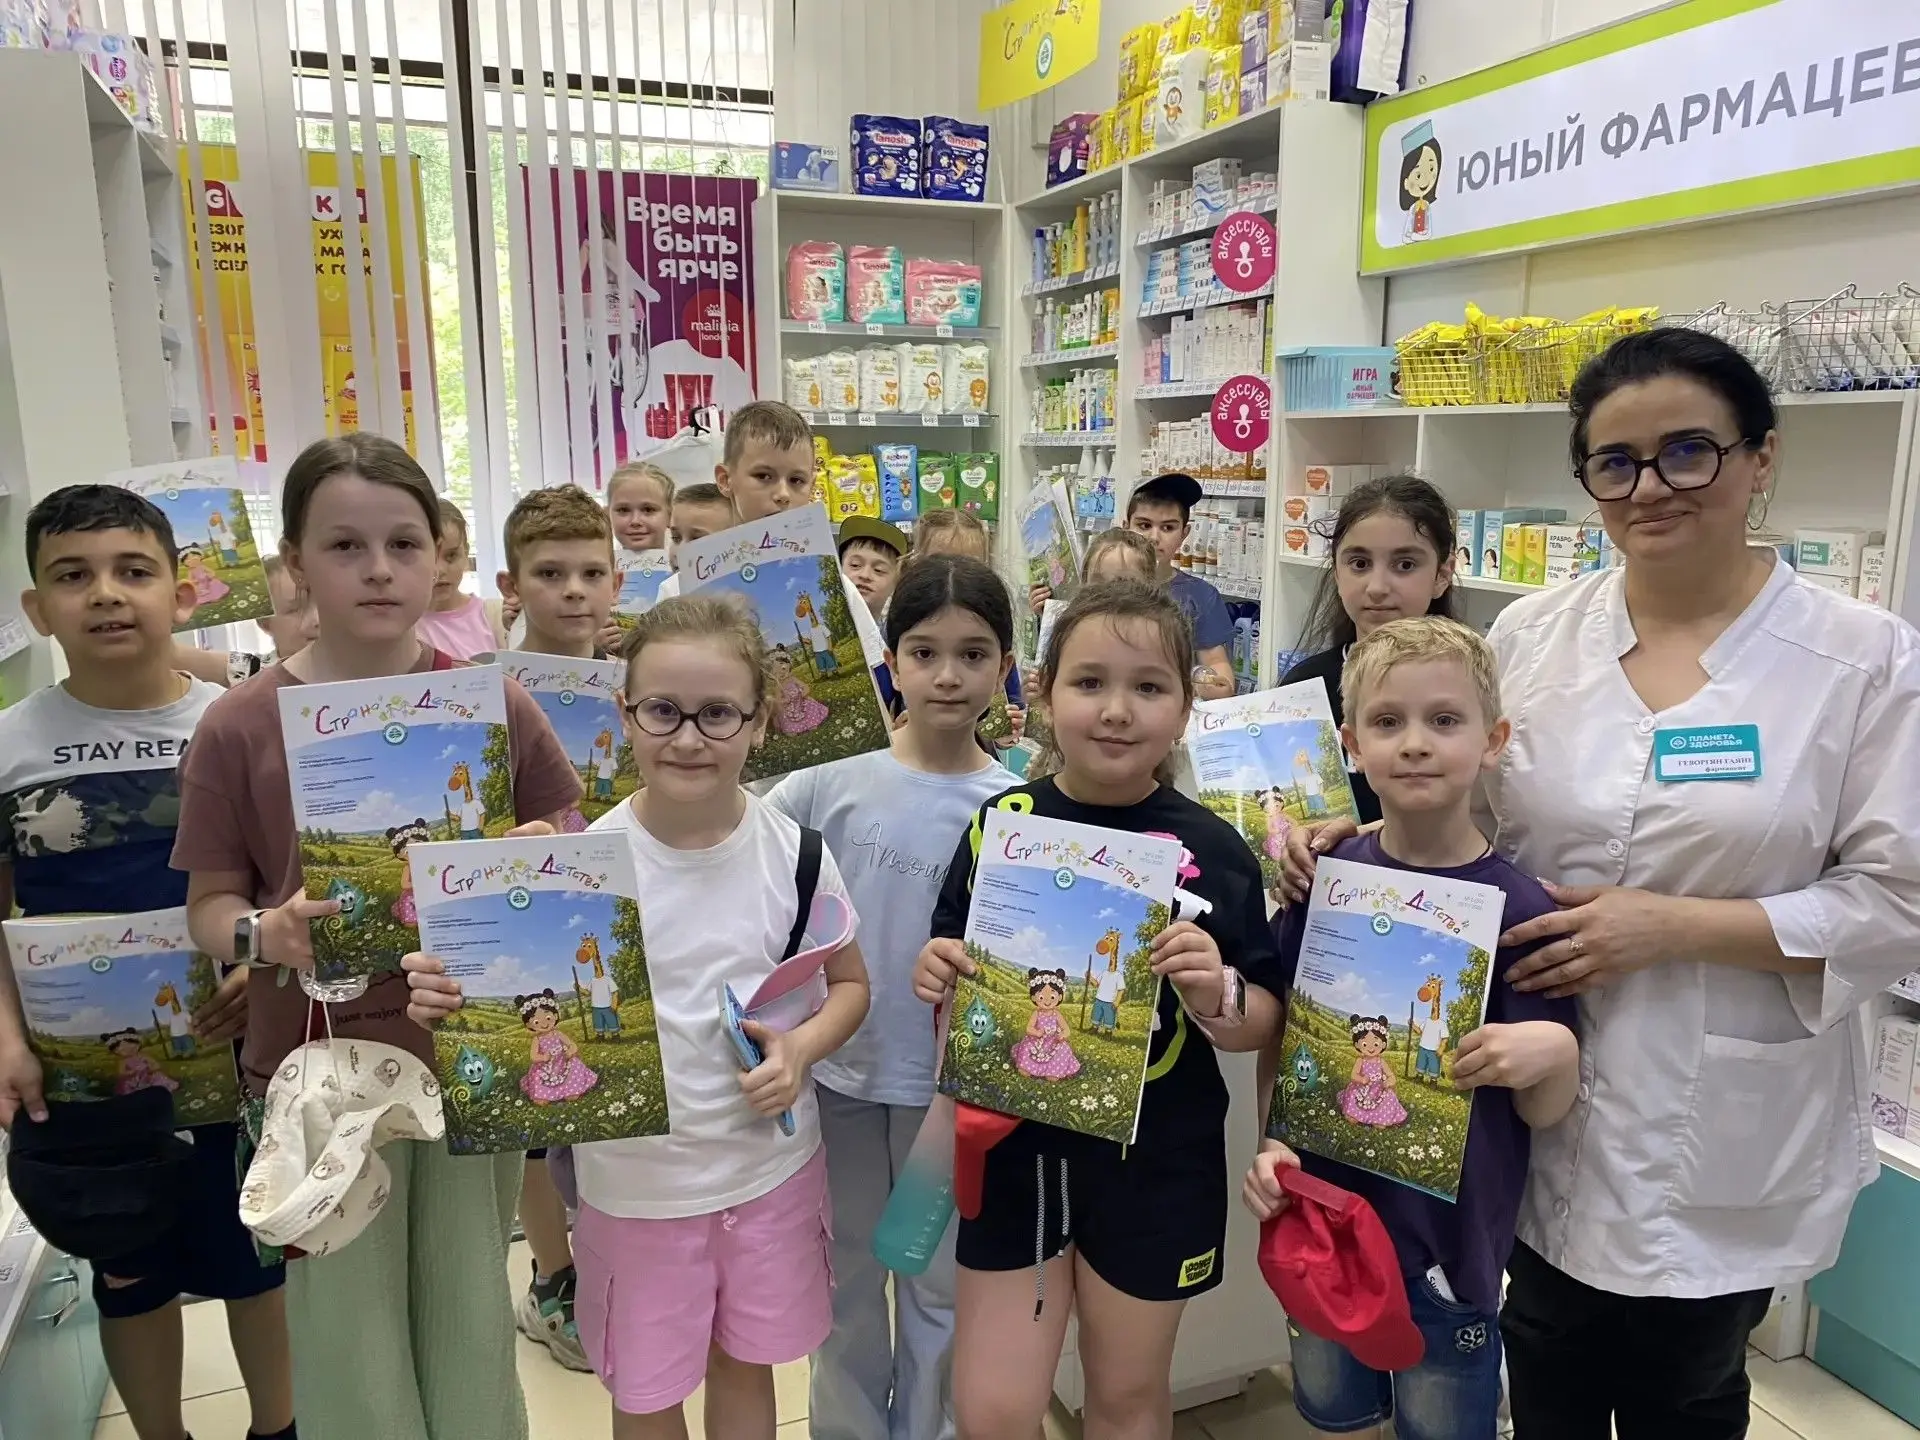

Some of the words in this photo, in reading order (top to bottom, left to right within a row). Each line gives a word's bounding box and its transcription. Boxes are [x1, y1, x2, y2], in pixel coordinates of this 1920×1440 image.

[1456, 112, 1586, 194] ЮНЫЙ
[627, 197, 737, 229] Время
[653, 226, 738, 255] быть
[1217, 219, 1273, 260] аксессуары
[658, 257, 738, 285] ярче
[1353, 368, 1378, 381] ИГРА
[1216, 382, 1270, 421] аксессуары
[314, 702, 381, 735] Страна
[414, 688, 475, 720] Детства
[53, 740, 125, 764] STAY
[1688, 733, 1735, 742] ПЛАНЕТА
[1689, 739, 1743, 748] ЗДОРОВЬЯ
[441, 861, 504, 896] Страна
[537, 852, 602, 890] Детства
[1003, 831, 1061, 861] Страна
[1088, 844, 1142, 890] Детства
[1326, 877, 1377, 907] Страна
[1405, 888, 1462, 936] Детства
[335, 1011, 362, 1027] just
[365, 1007, 403, 1022] enjoy
